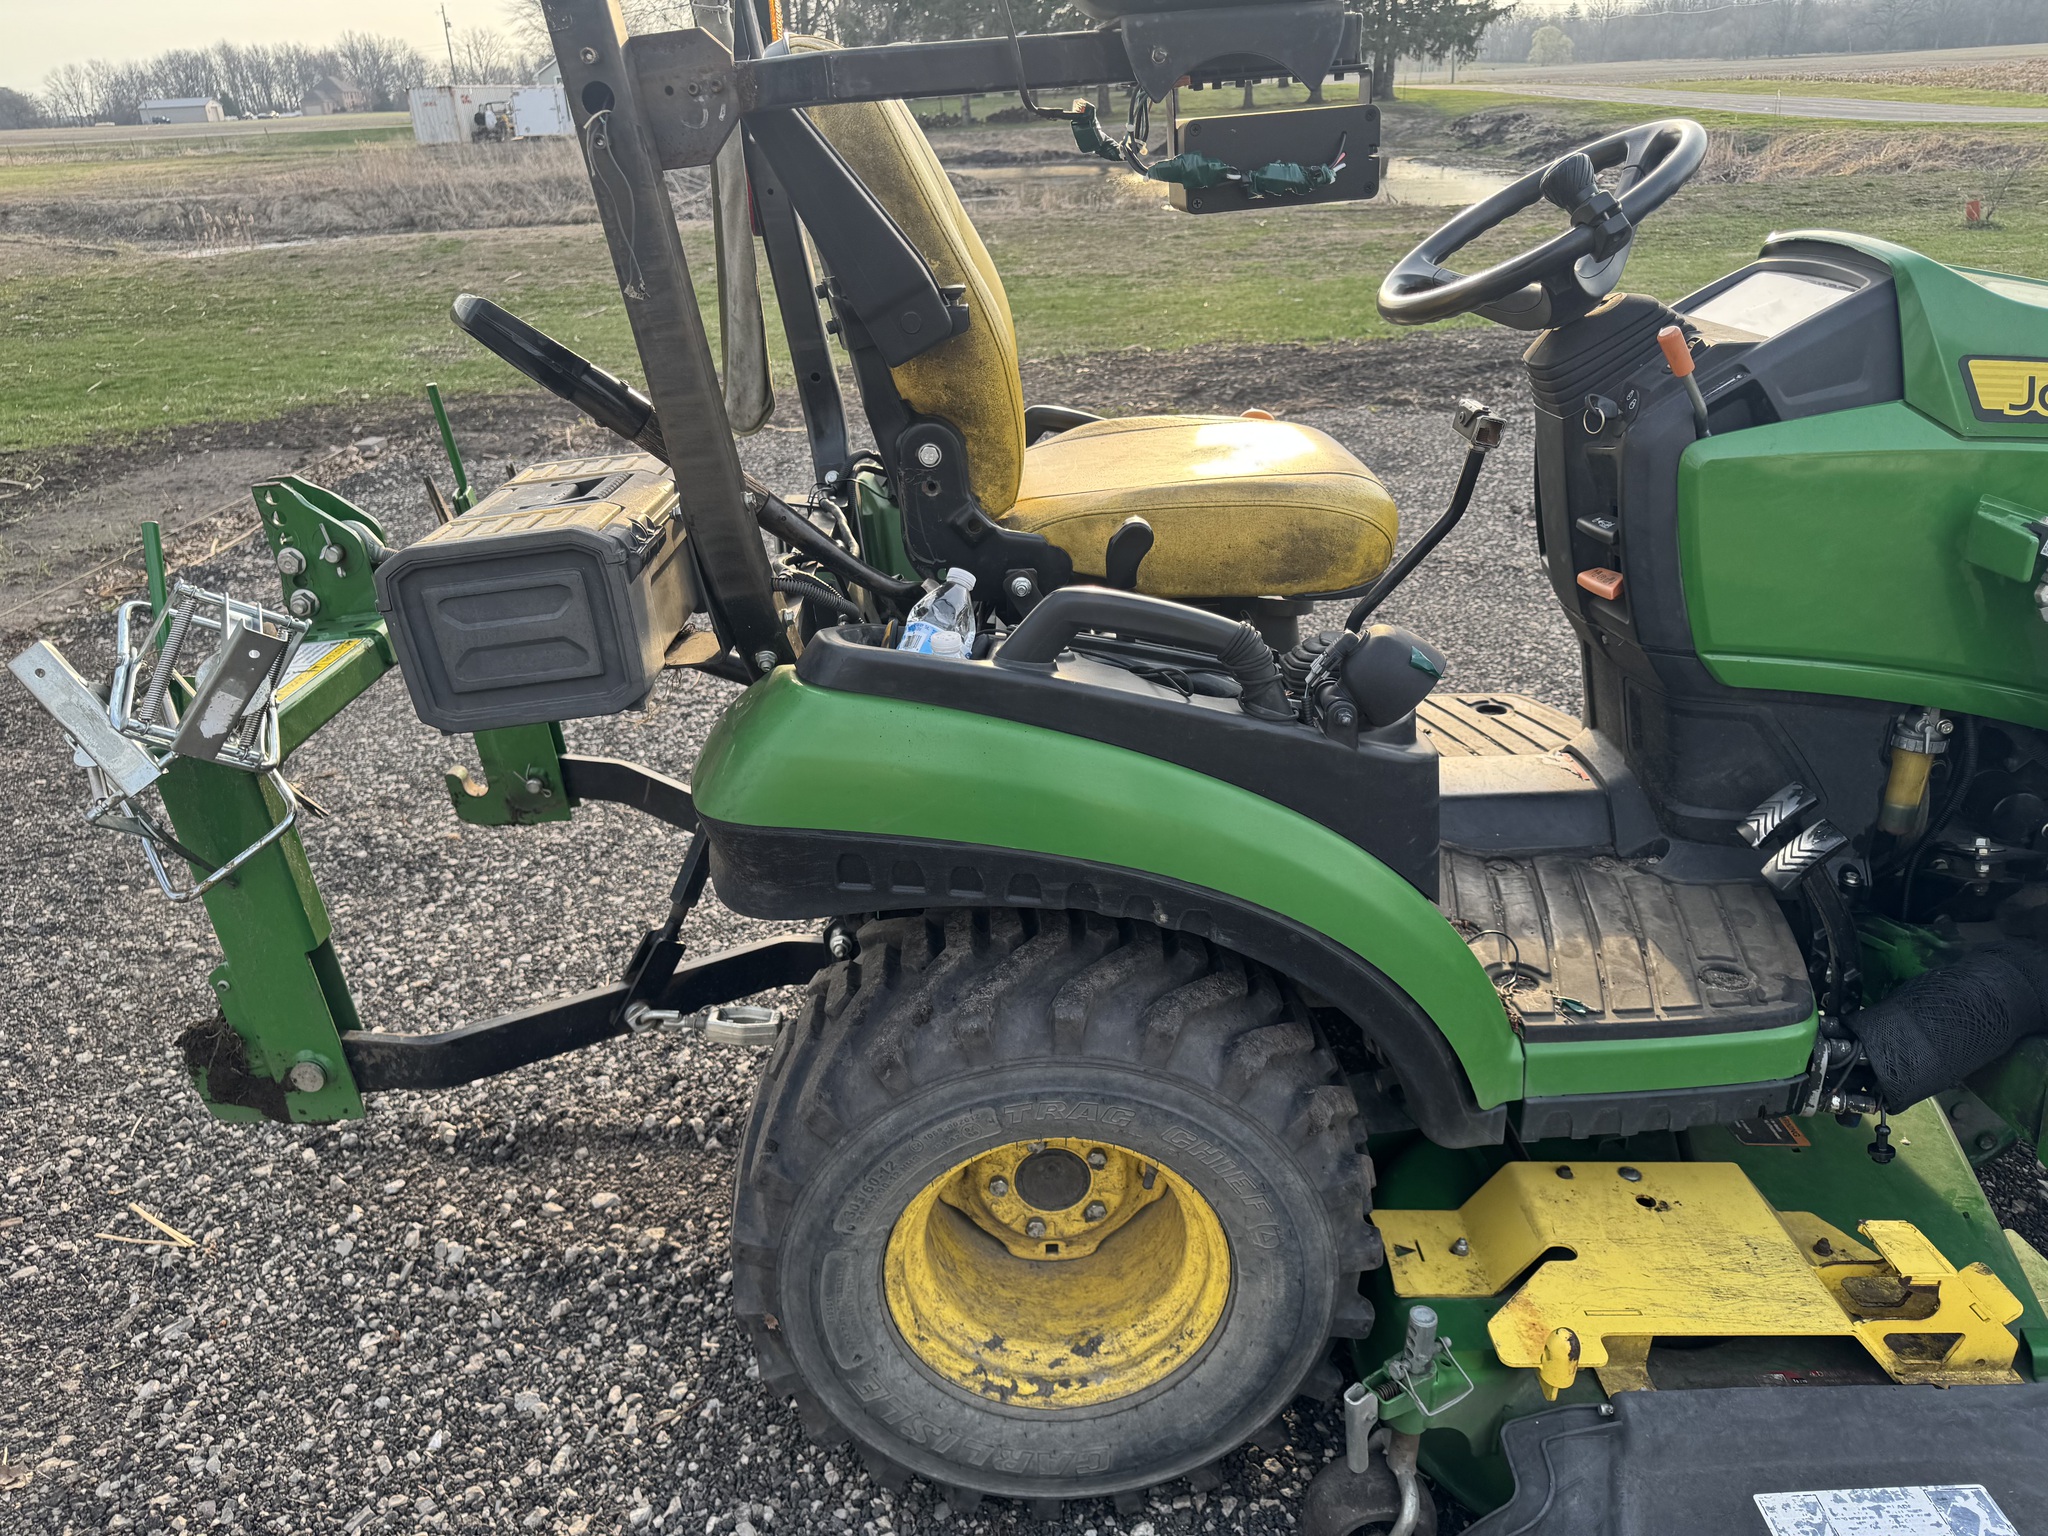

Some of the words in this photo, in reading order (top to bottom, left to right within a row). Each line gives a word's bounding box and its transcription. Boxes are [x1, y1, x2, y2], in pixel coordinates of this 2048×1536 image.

[843, 1160, 897, 1220] 305/60-12
[1004, 1100, 1136, 1127] TRAC
[1160, 1125, 1277, 1216] CHIEF
[848, 1371, 1113, 1476] CARLISLE
